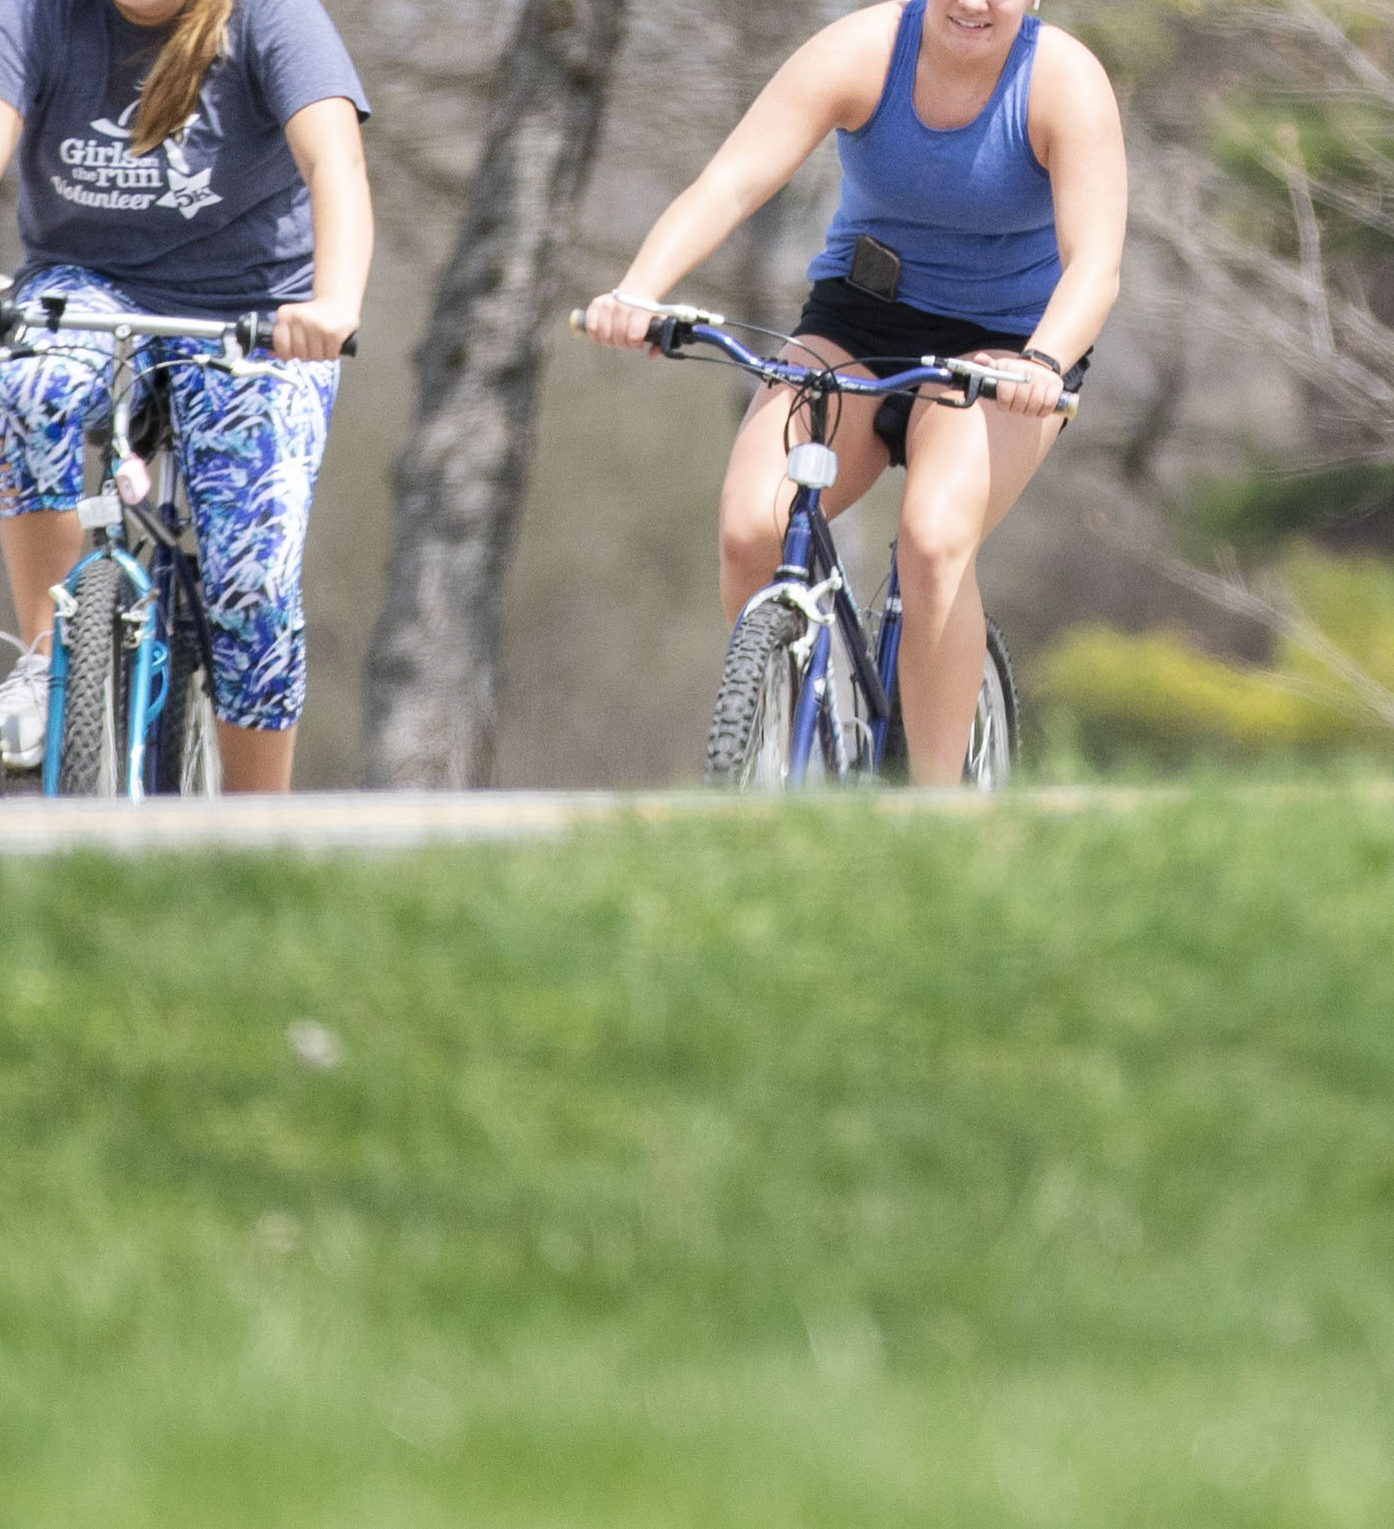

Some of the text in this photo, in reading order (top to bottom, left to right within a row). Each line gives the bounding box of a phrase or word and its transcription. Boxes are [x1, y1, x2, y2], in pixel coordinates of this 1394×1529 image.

[60, 138, 137, 167] Girls
[96, 167, 163, 187] run
[50, 176, 157, 210] Volunteer
